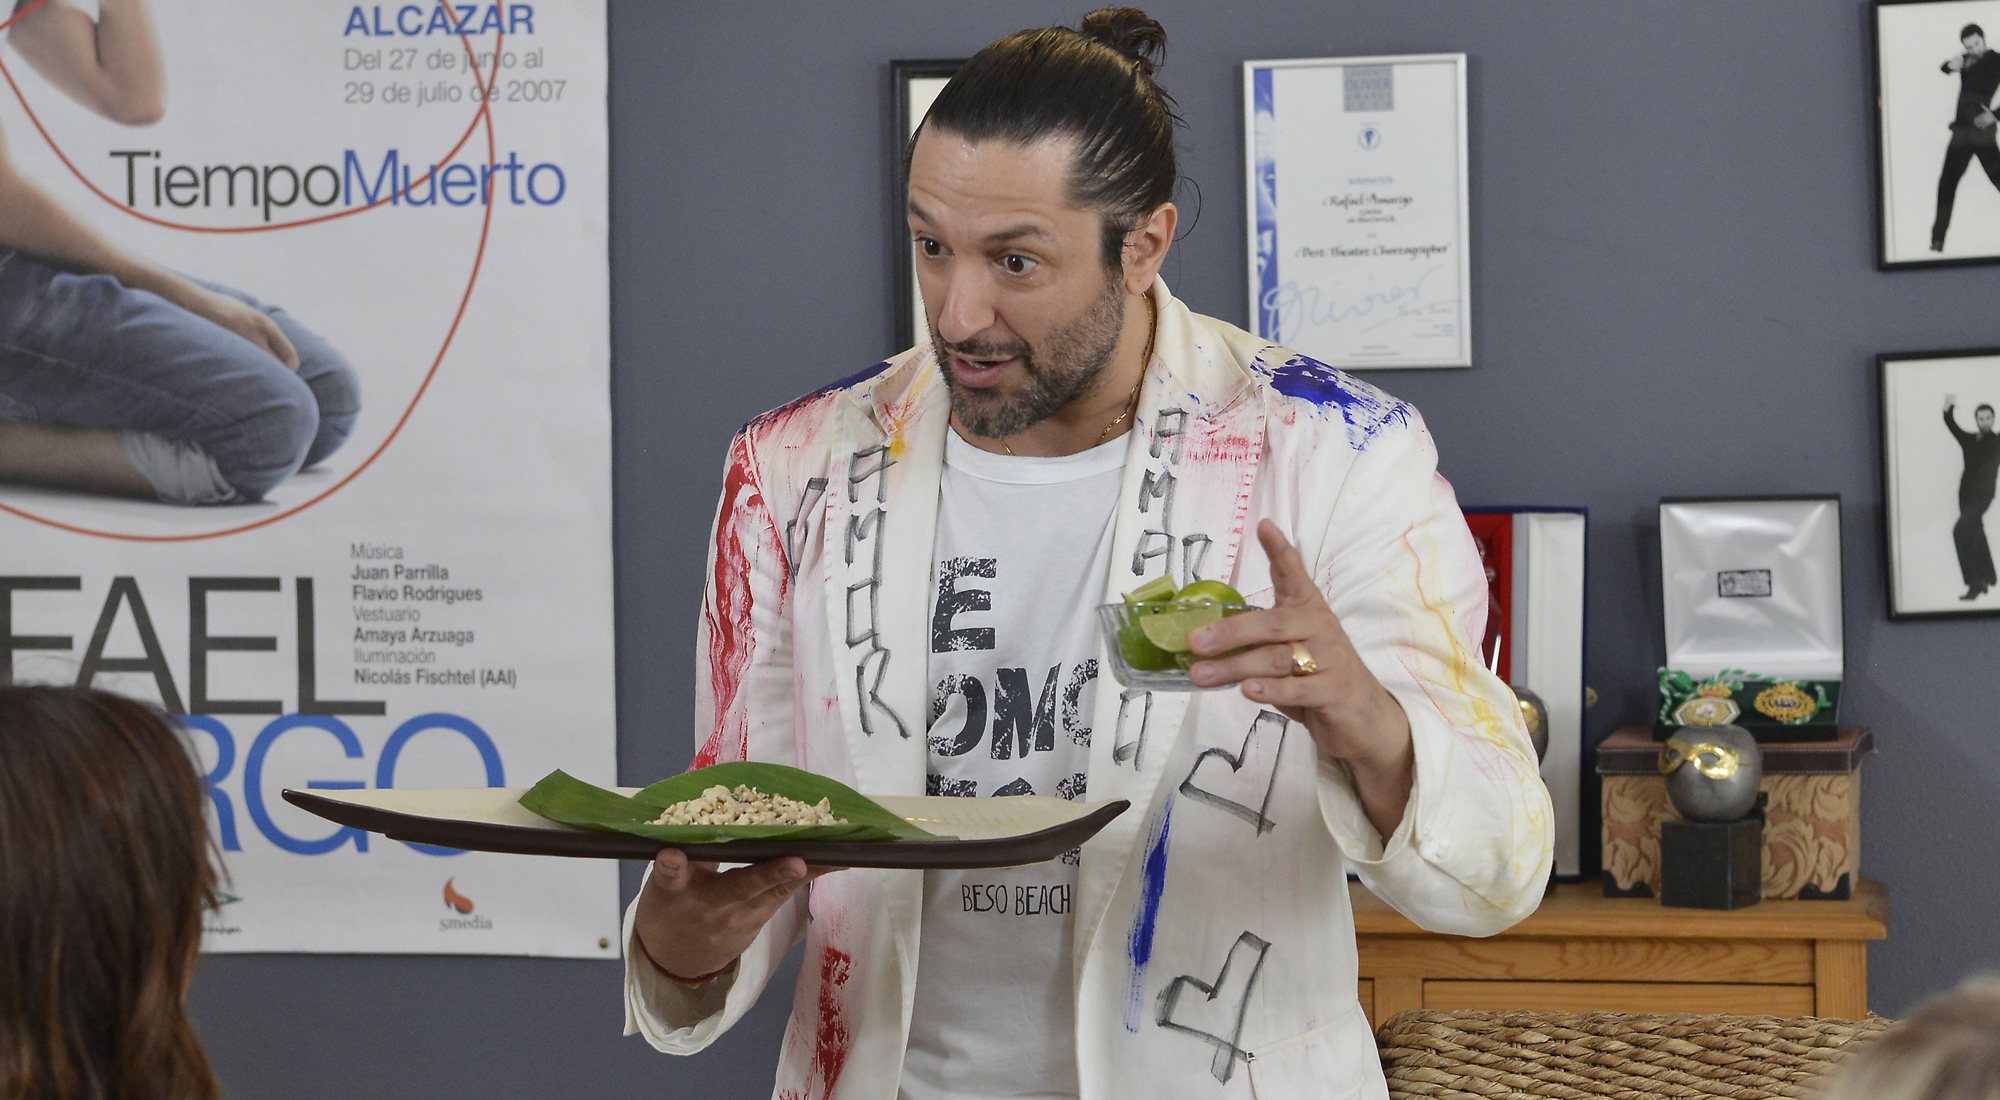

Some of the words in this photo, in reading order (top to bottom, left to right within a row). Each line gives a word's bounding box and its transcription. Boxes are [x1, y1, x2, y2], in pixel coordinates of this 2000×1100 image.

[344, 48, 381, 71] Del
[389, 48, 418, 71] 27
[426, 48, 456, 70] de
[461, 48, 517, 75] junio
[523, 47, 544, 69] al
[344, 81, 375, 105] 29
[381, 81, 412, 104] de
[416, 80, 463, 108] julio
[469, 80, 500, 102] de
[507, 80, 567, 103] 2007
[351, 543, 404, 560] Música
[352, 564, 389, 580] Juan
[394, 564, 449, 580] Parrilla
[353, 585, 398, 601] Flavio
[402, 584, 483, 605] Rodrigues
[352, 605, 422, 622] Vestuario
[354, 627, 406, 646] Amaya
[411, 627, 475, 647] Arzuaga
[353, 648, 436, 664] Iluminación
[354, 668, 411, 685] Nicolás
[416, 668, 476, 685] Fischtel
[480, 668, 517, 689] (AAI)
[961, 884, 1008, 914] BESO
[1015, 884, 1071, 916] BEACH
